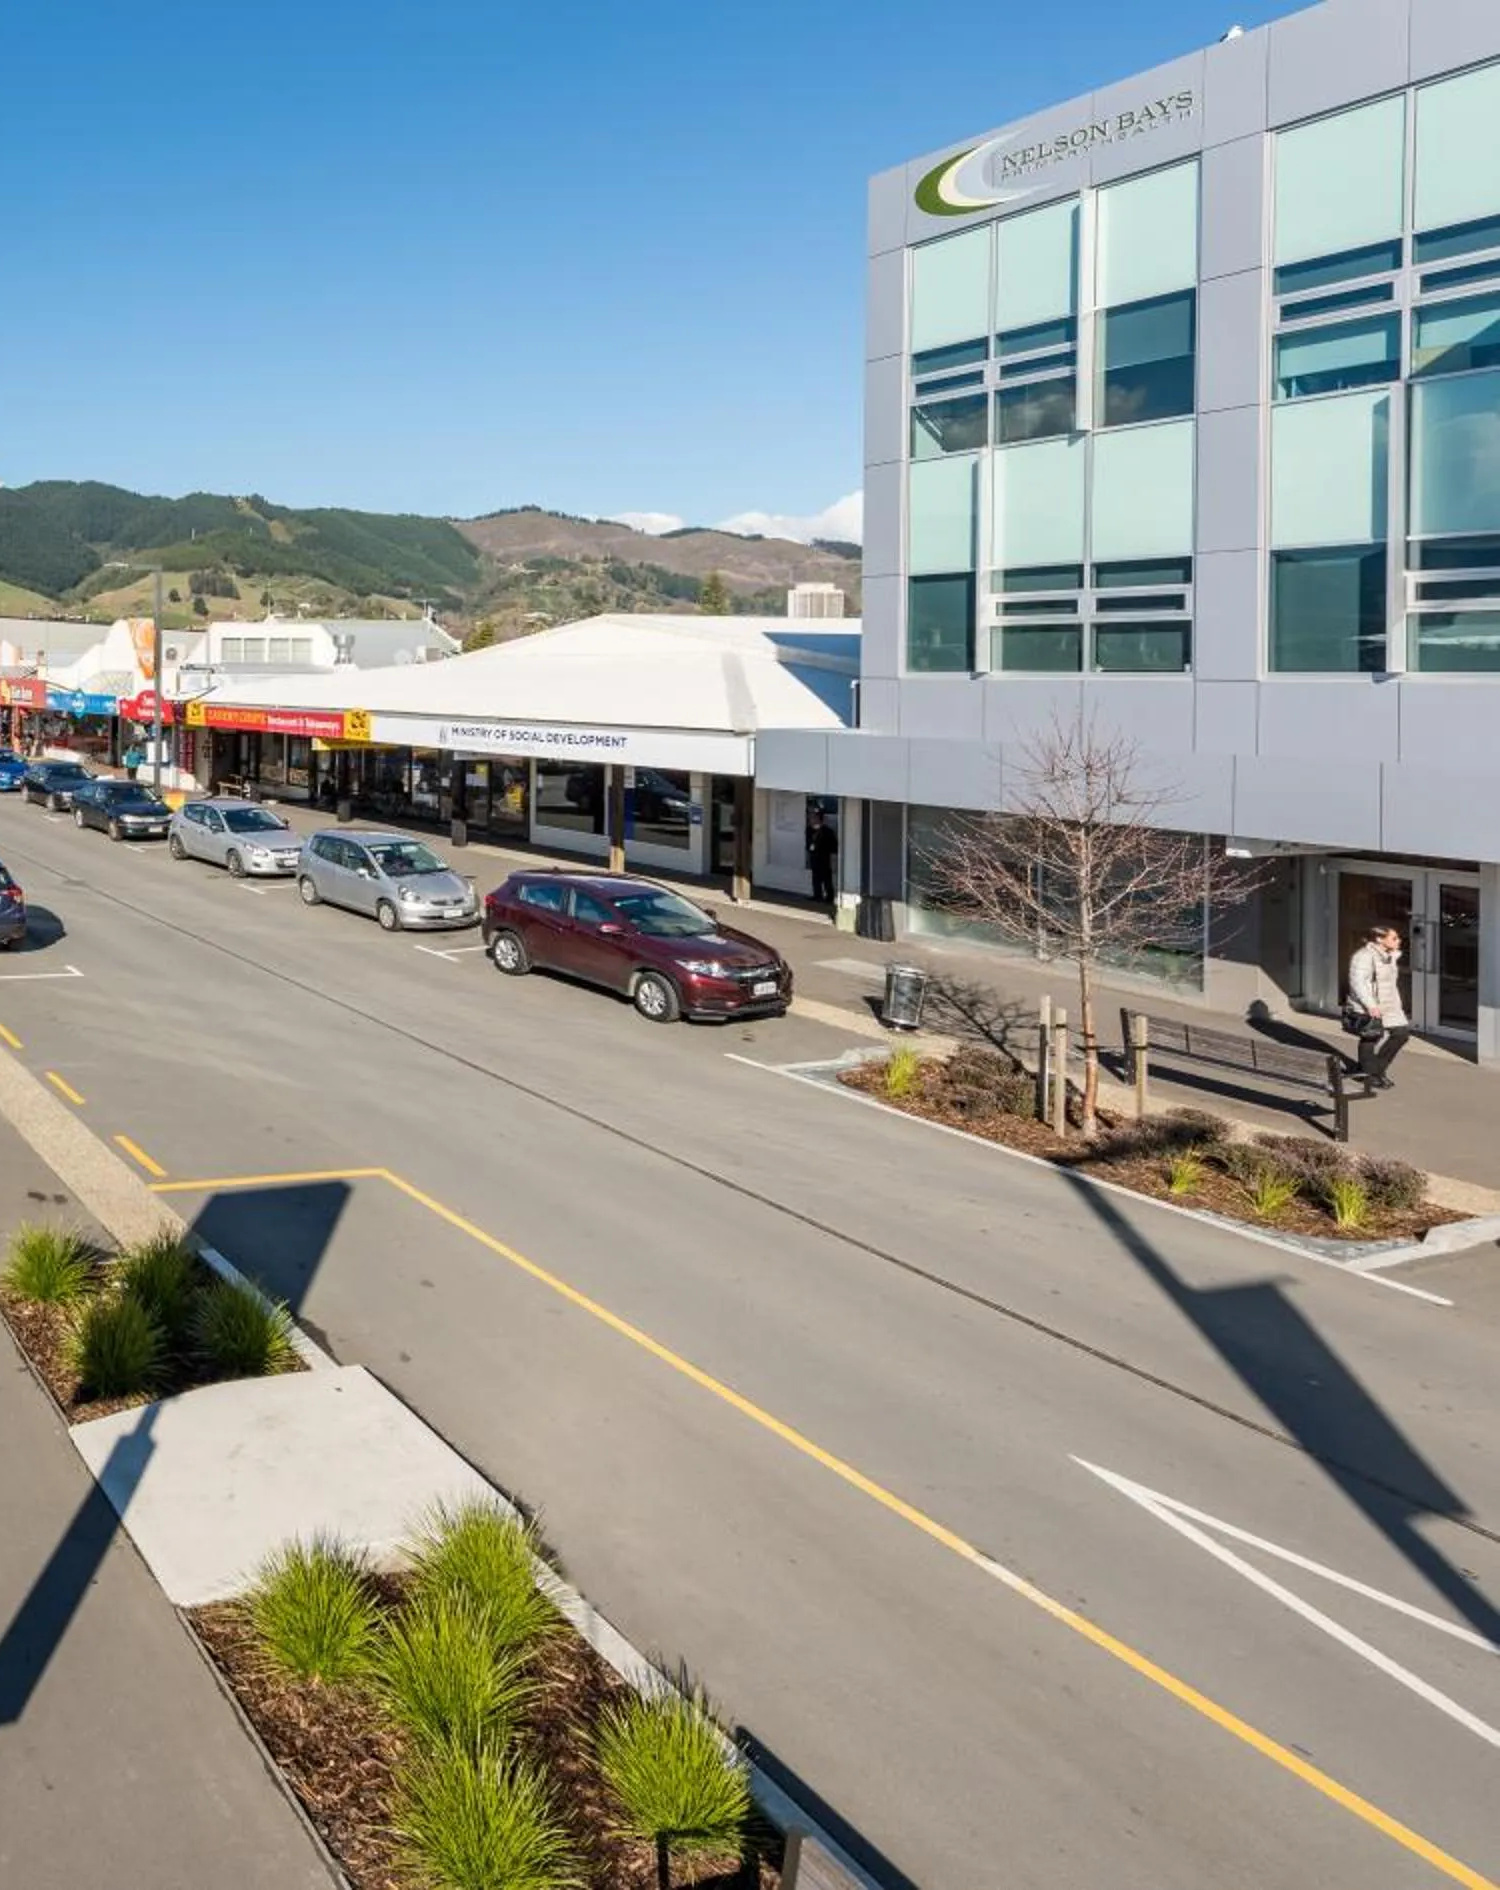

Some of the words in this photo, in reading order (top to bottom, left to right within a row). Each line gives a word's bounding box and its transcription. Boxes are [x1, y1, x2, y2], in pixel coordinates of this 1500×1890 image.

[1002, 120, 1109, 172] NELSON
[1117, 90, 1193, 131] BAYS
[451, 726, 492, 739] MINISTRY
[494, 729, 507, 740] OF
[509, 731, 545, 743] SOCIAL
[547, 733, 628, 748] DEVELOPMENT
